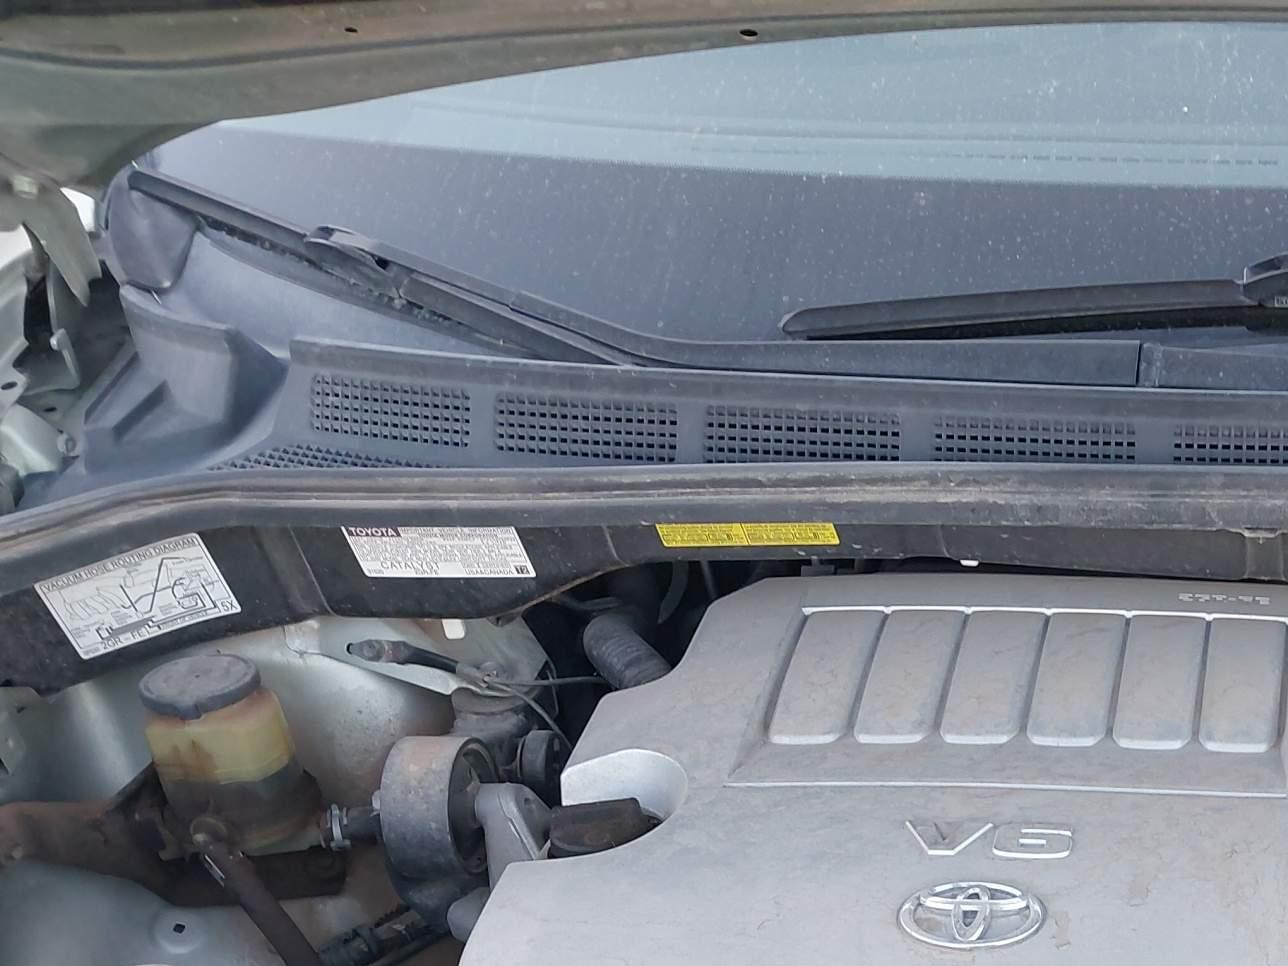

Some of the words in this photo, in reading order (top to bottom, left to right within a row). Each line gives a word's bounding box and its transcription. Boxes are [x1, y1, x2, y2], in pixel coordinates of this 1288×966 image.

[350, 528, 396, 537] TOYOTA
[44, 573, 83, 593] VACUUM
[84, 564, 111, 580] HOSE
[111, 550, 153, 569] ROUTING
[153, 537, 195, 555] DIAGRAM
[381, 561, 439, 570] CATALYST
[221, 600, 238, 612] 5X
[904, 820, 1073, 860] V6
